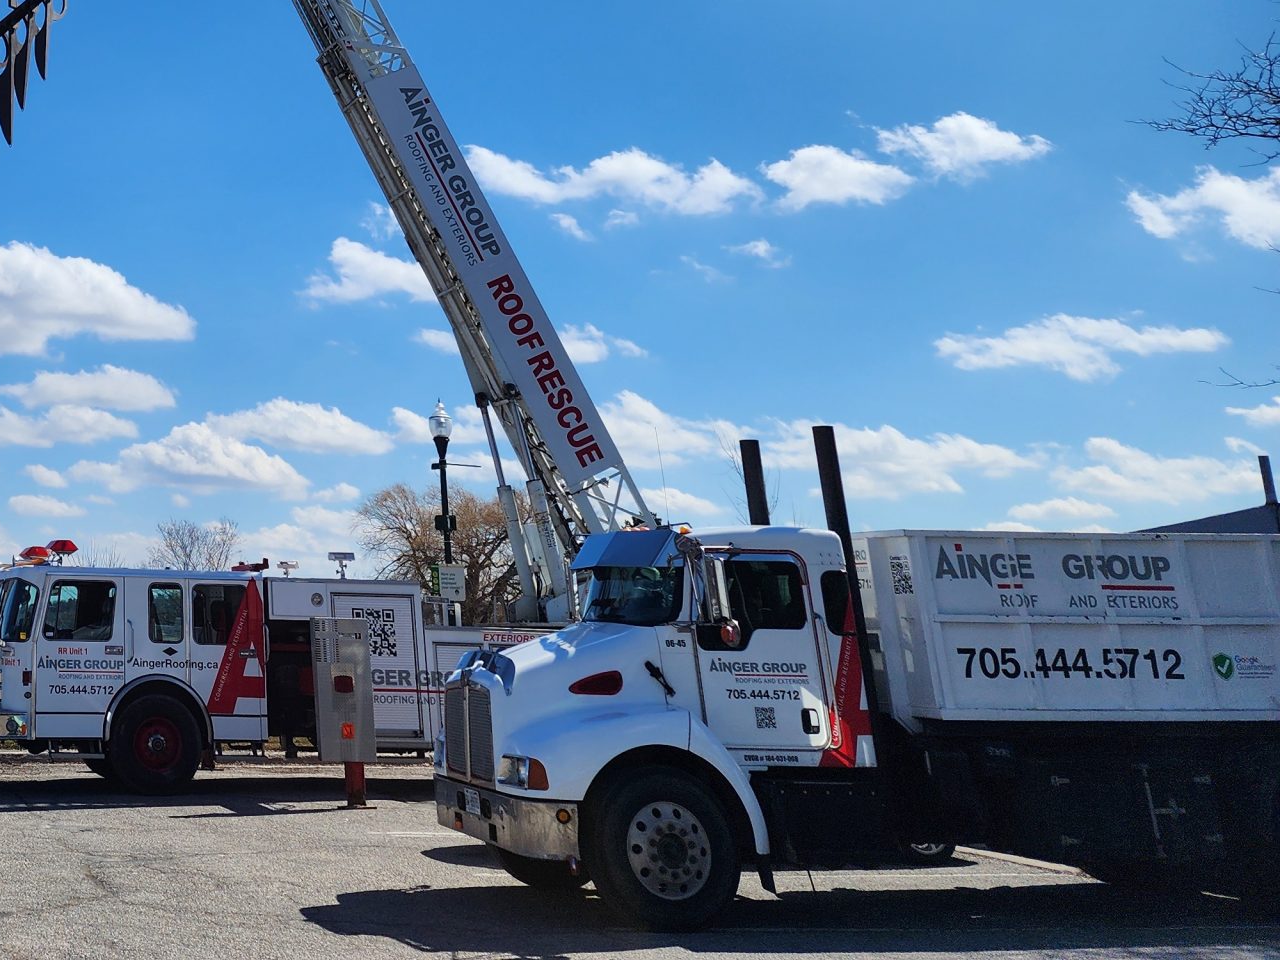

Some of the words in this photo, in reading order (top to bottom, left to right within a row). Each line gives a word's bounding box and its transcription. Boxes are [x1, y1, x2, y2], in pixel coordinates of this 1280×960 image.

[404, 134, 434, 184] ROOFING
[428, 183, 448, 208] AND
[441, 206, 479, 267] EXTERIORS
[447, 174, 501, 257] GROUP
[486, 273, 545, 351] ROOF
[526, 350, 604, 469] RESCUE
[1070, 594, 1098, 609] AND
[84, 659, 124, 670] GROUP
[132, 658, 218, 671] AingerRoofing.ca
[762, 662, 807, 674] GROUP
[48, 685, 114, 695] 705.444.5712
[726, 689, 800, 700] 705.444.5712
[373, 695, 414, 704] ROOFING
